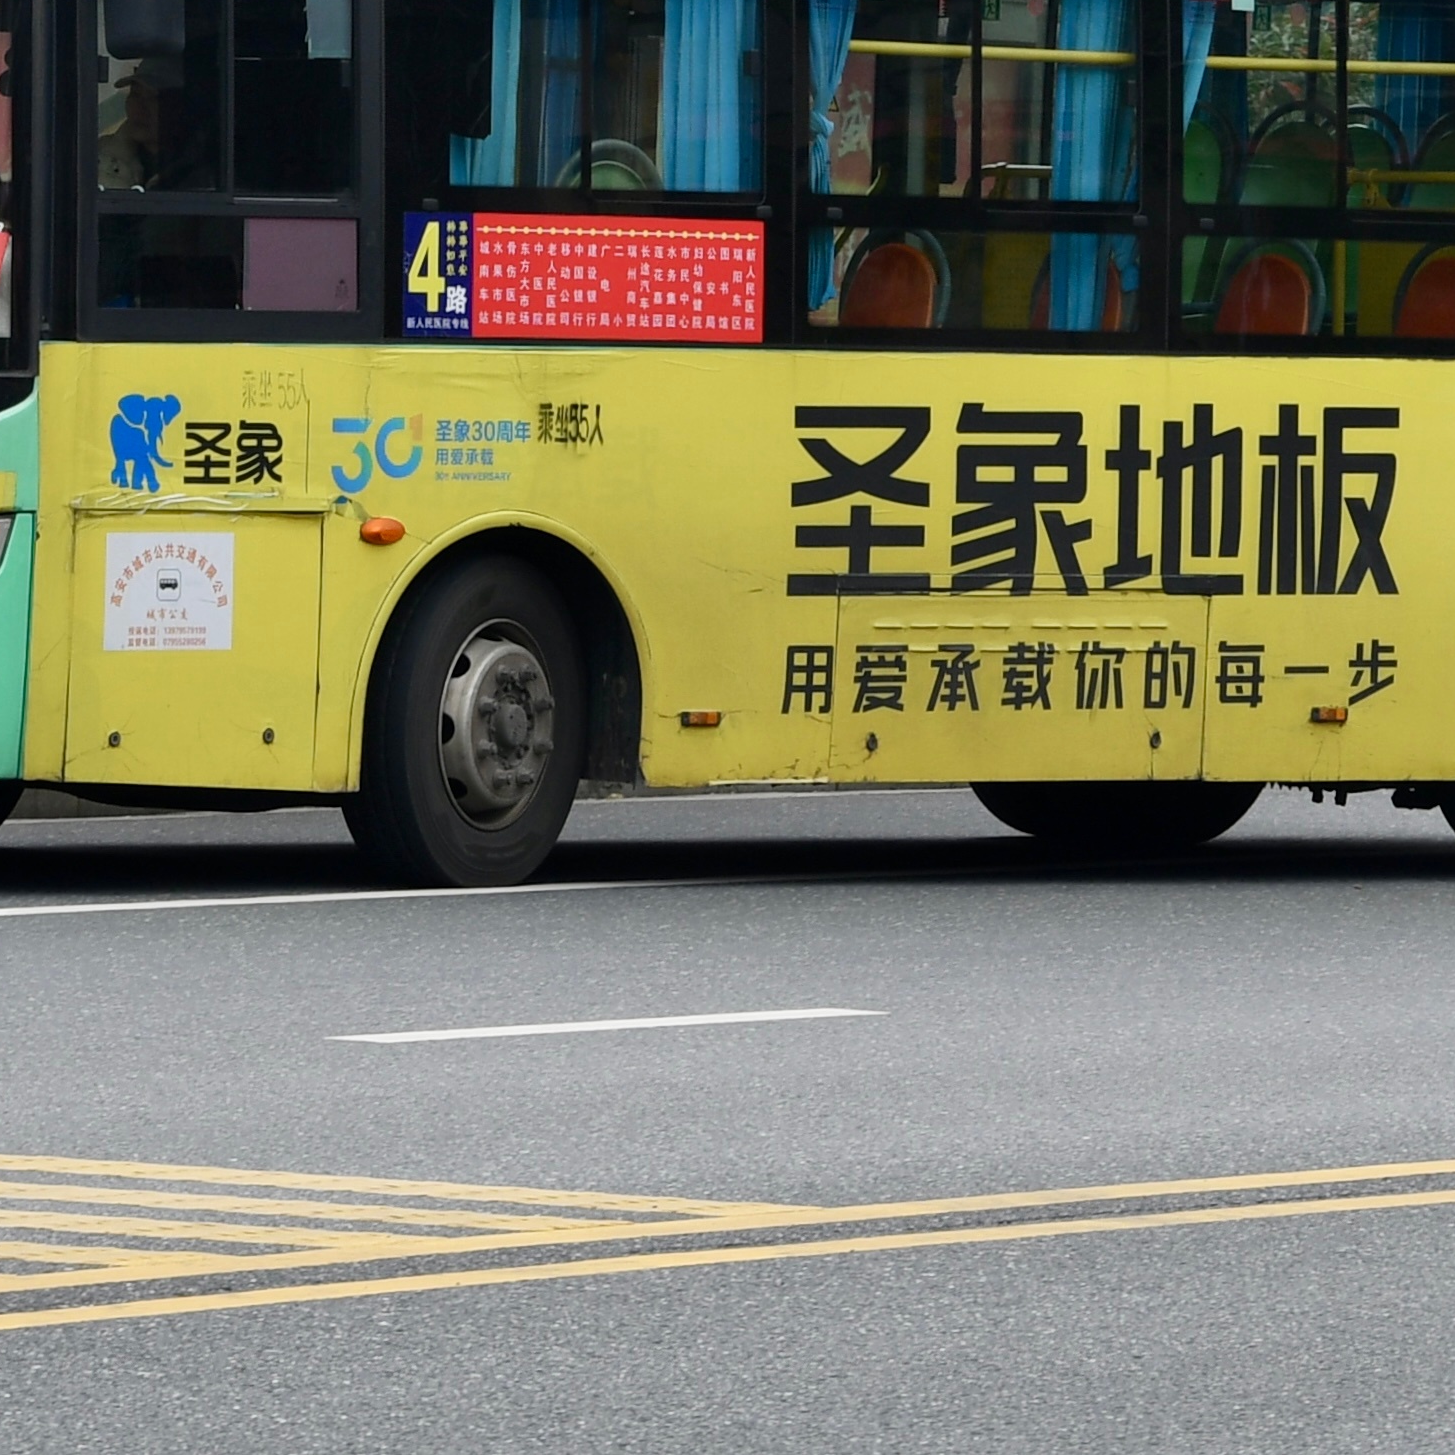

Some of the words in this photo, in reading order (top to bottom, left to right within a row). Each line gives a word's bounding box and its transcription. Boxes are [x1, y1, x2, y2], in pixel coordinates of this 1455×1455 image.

[406, 317, 470, 330] 新人民医院专线
[479, 240, 490, 325] 城南车站
[492, 241, 503, 324] 水果市场
[505, 241, 517, 325] 骨伤医院
[519, 242, 530, 325] 东方大市场
[533, 242, 544, 325] 中医院
[546, 242, 557, 326] 老人民医院
[560, 242, 571, 326] 移动公司
[572, 243, 584, 327] 中国银行
[586, 243, 598, 327] 建设银行
[599, 244, 611, 327] 广电局
[613, 245, 624, 327] 二小
[639, 245, 650, 328] 长途汽车站
[666, 246, 677, 328] 水务集团
[679, 246, 690, 329] 市民中心
[692, 247, 704, 329] 妇幼保健院
[705, 247, 717, 329] 公安局
[718, 247, 730, 330] 图书馆
[745, 248, 756, 330] 新人民医院
[183, 419, 284, 486] 圣象
[435, 418, 532, 445] 圣象30周年
[435, 448, 495, 467] 用爱承载
[786, 402, 1400, 597] 圣象地板
[781, 639, 1399, 715] 用爱承载你的每一步
